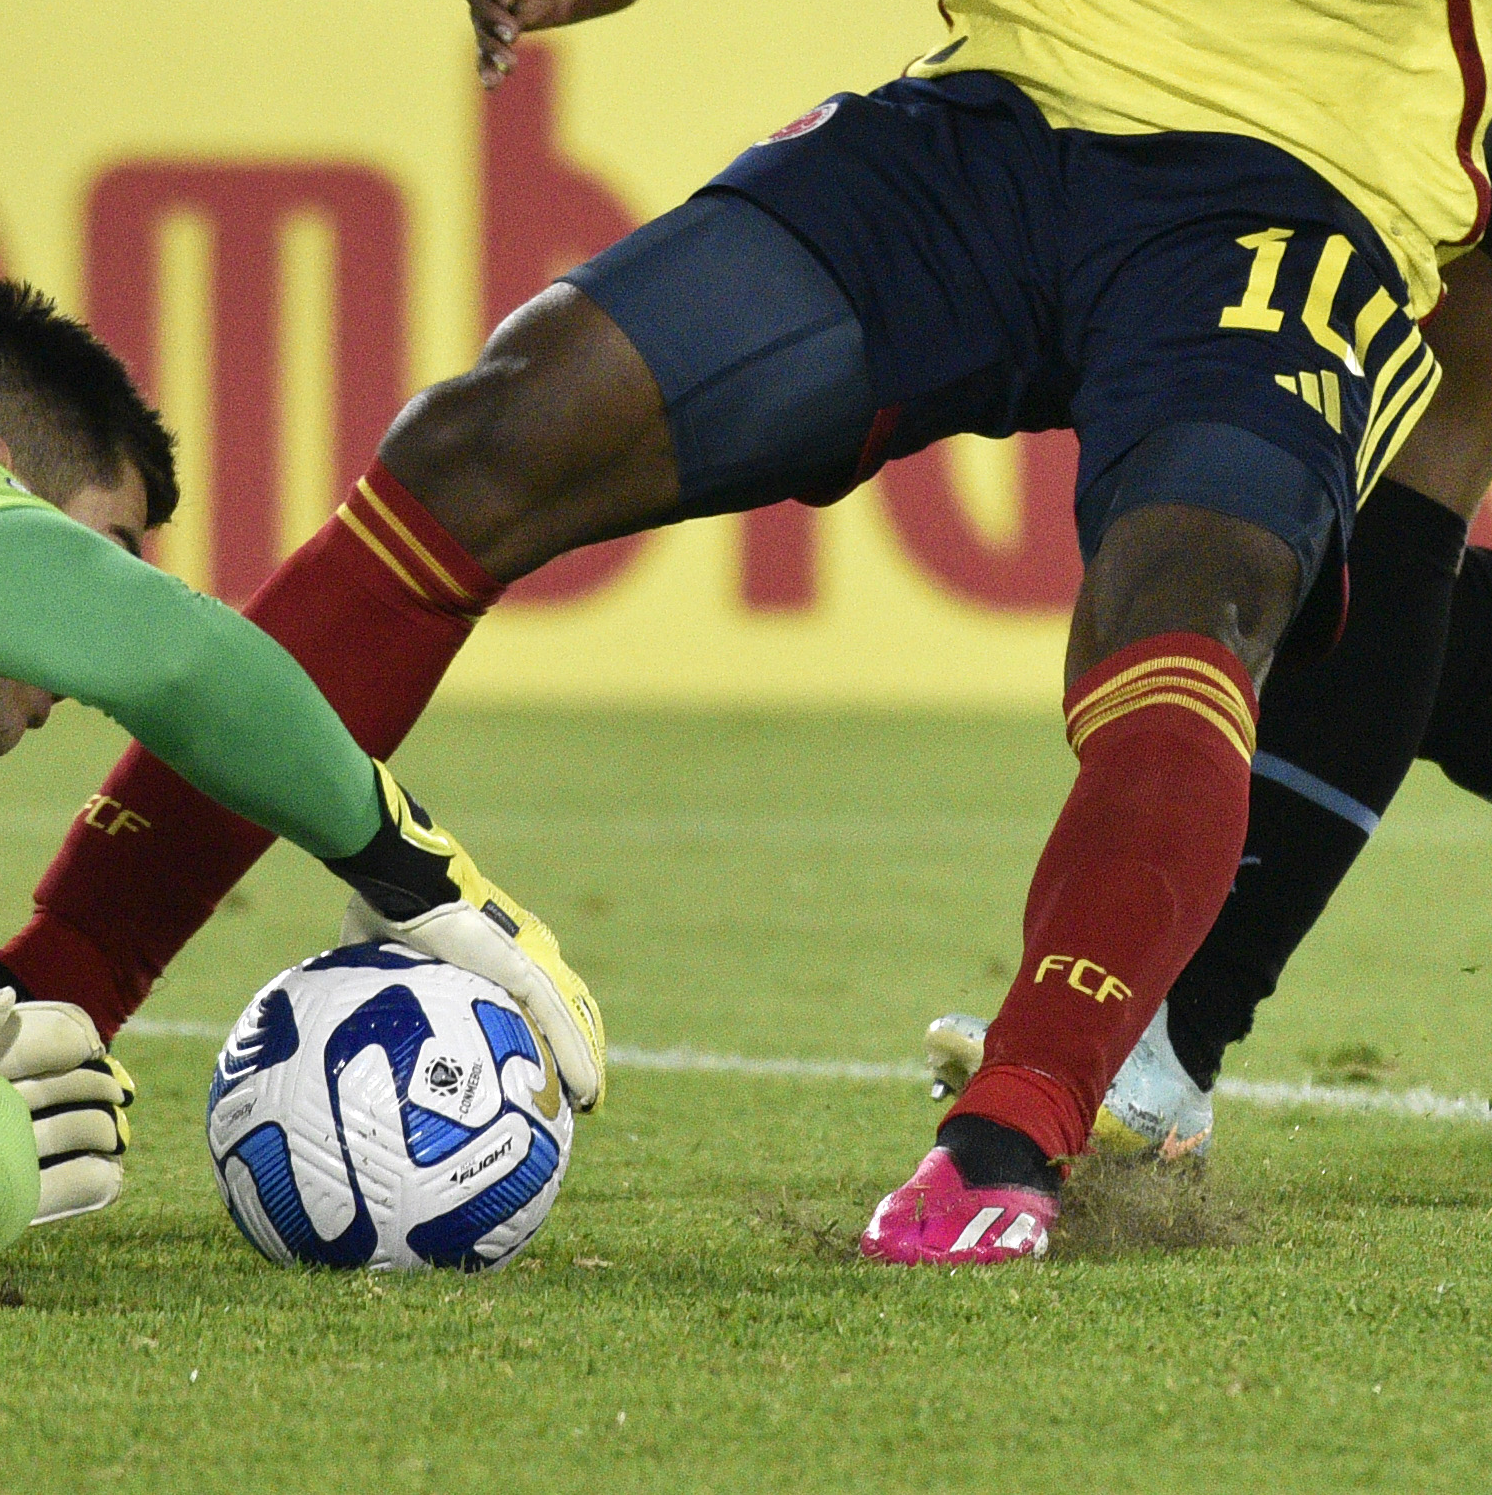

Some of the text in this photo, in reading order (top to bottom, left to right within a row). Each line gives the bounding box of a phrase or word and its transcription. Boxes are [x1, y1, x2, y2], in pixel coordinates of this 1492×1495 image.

[1218, 226, 1399, 378] 10
[1033, 954, 1133, 1004] FCF
[458, 1136, 514, 1185] FLIGHT
